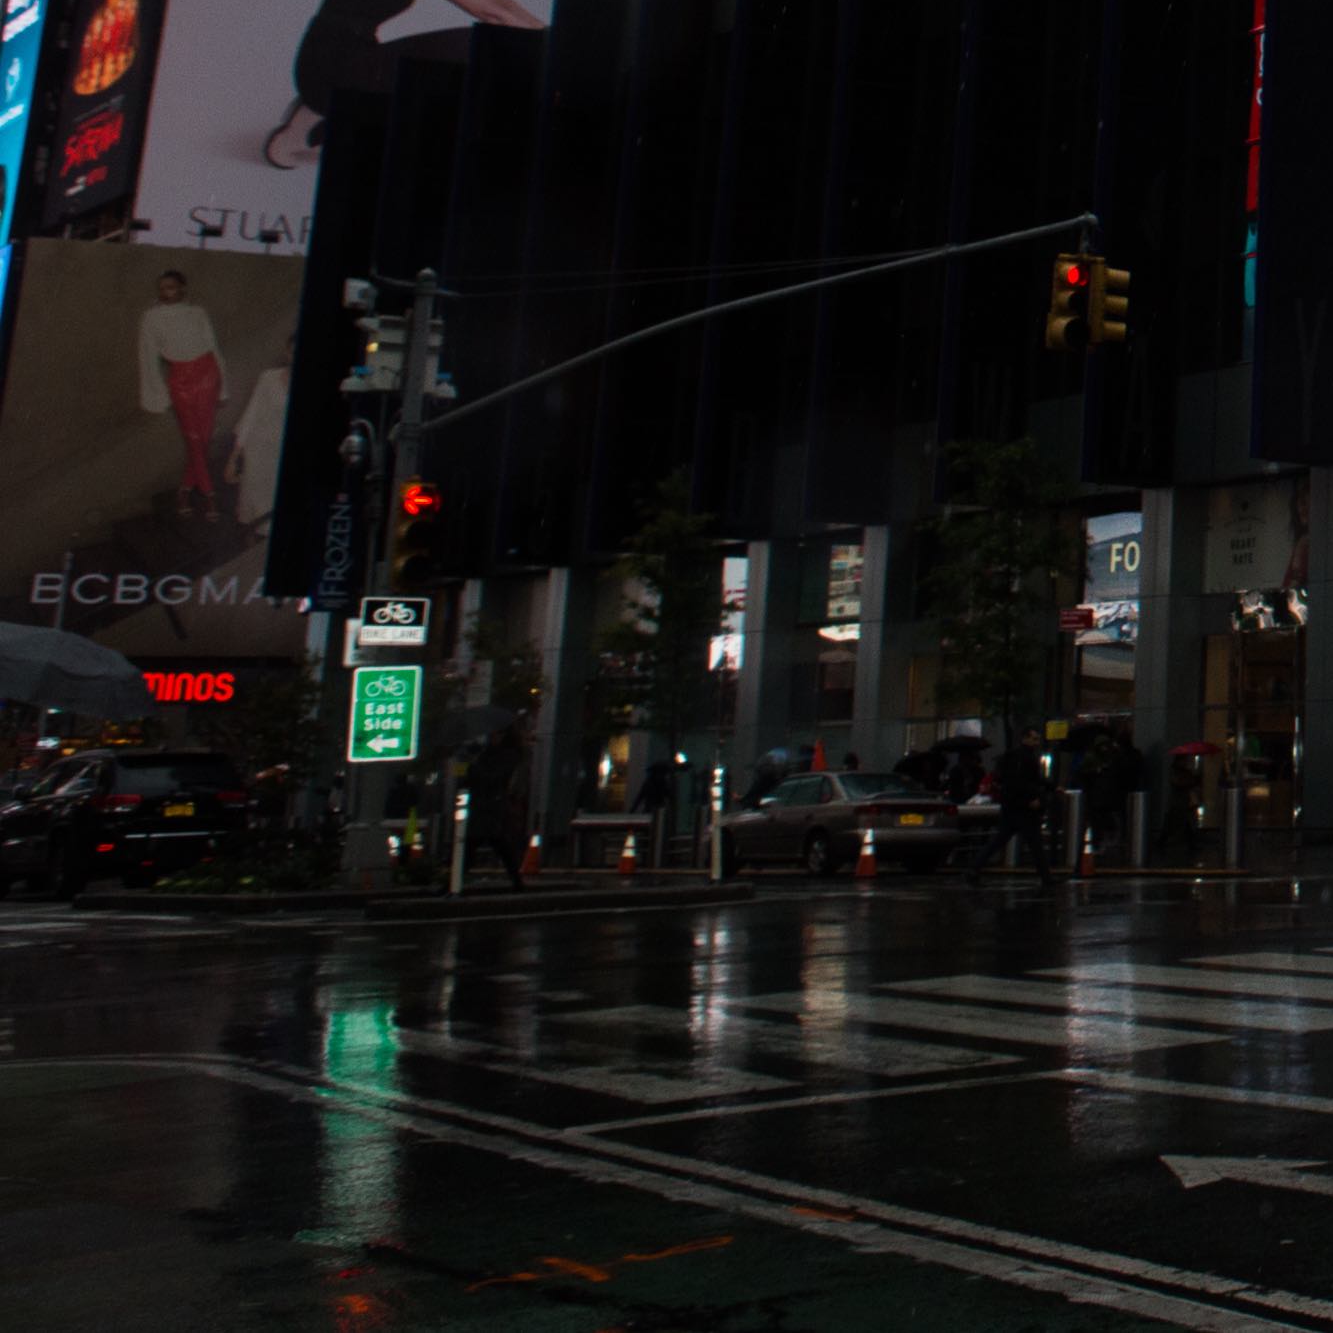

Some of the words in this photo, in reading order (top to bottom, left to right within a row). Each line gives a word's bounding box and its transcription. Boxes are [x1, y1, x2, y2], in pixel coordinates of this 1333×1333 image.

[1110, 541, 1141, 573] FO
[364, 702, 405, 716] East
[363, 717, 404, 732] Side
